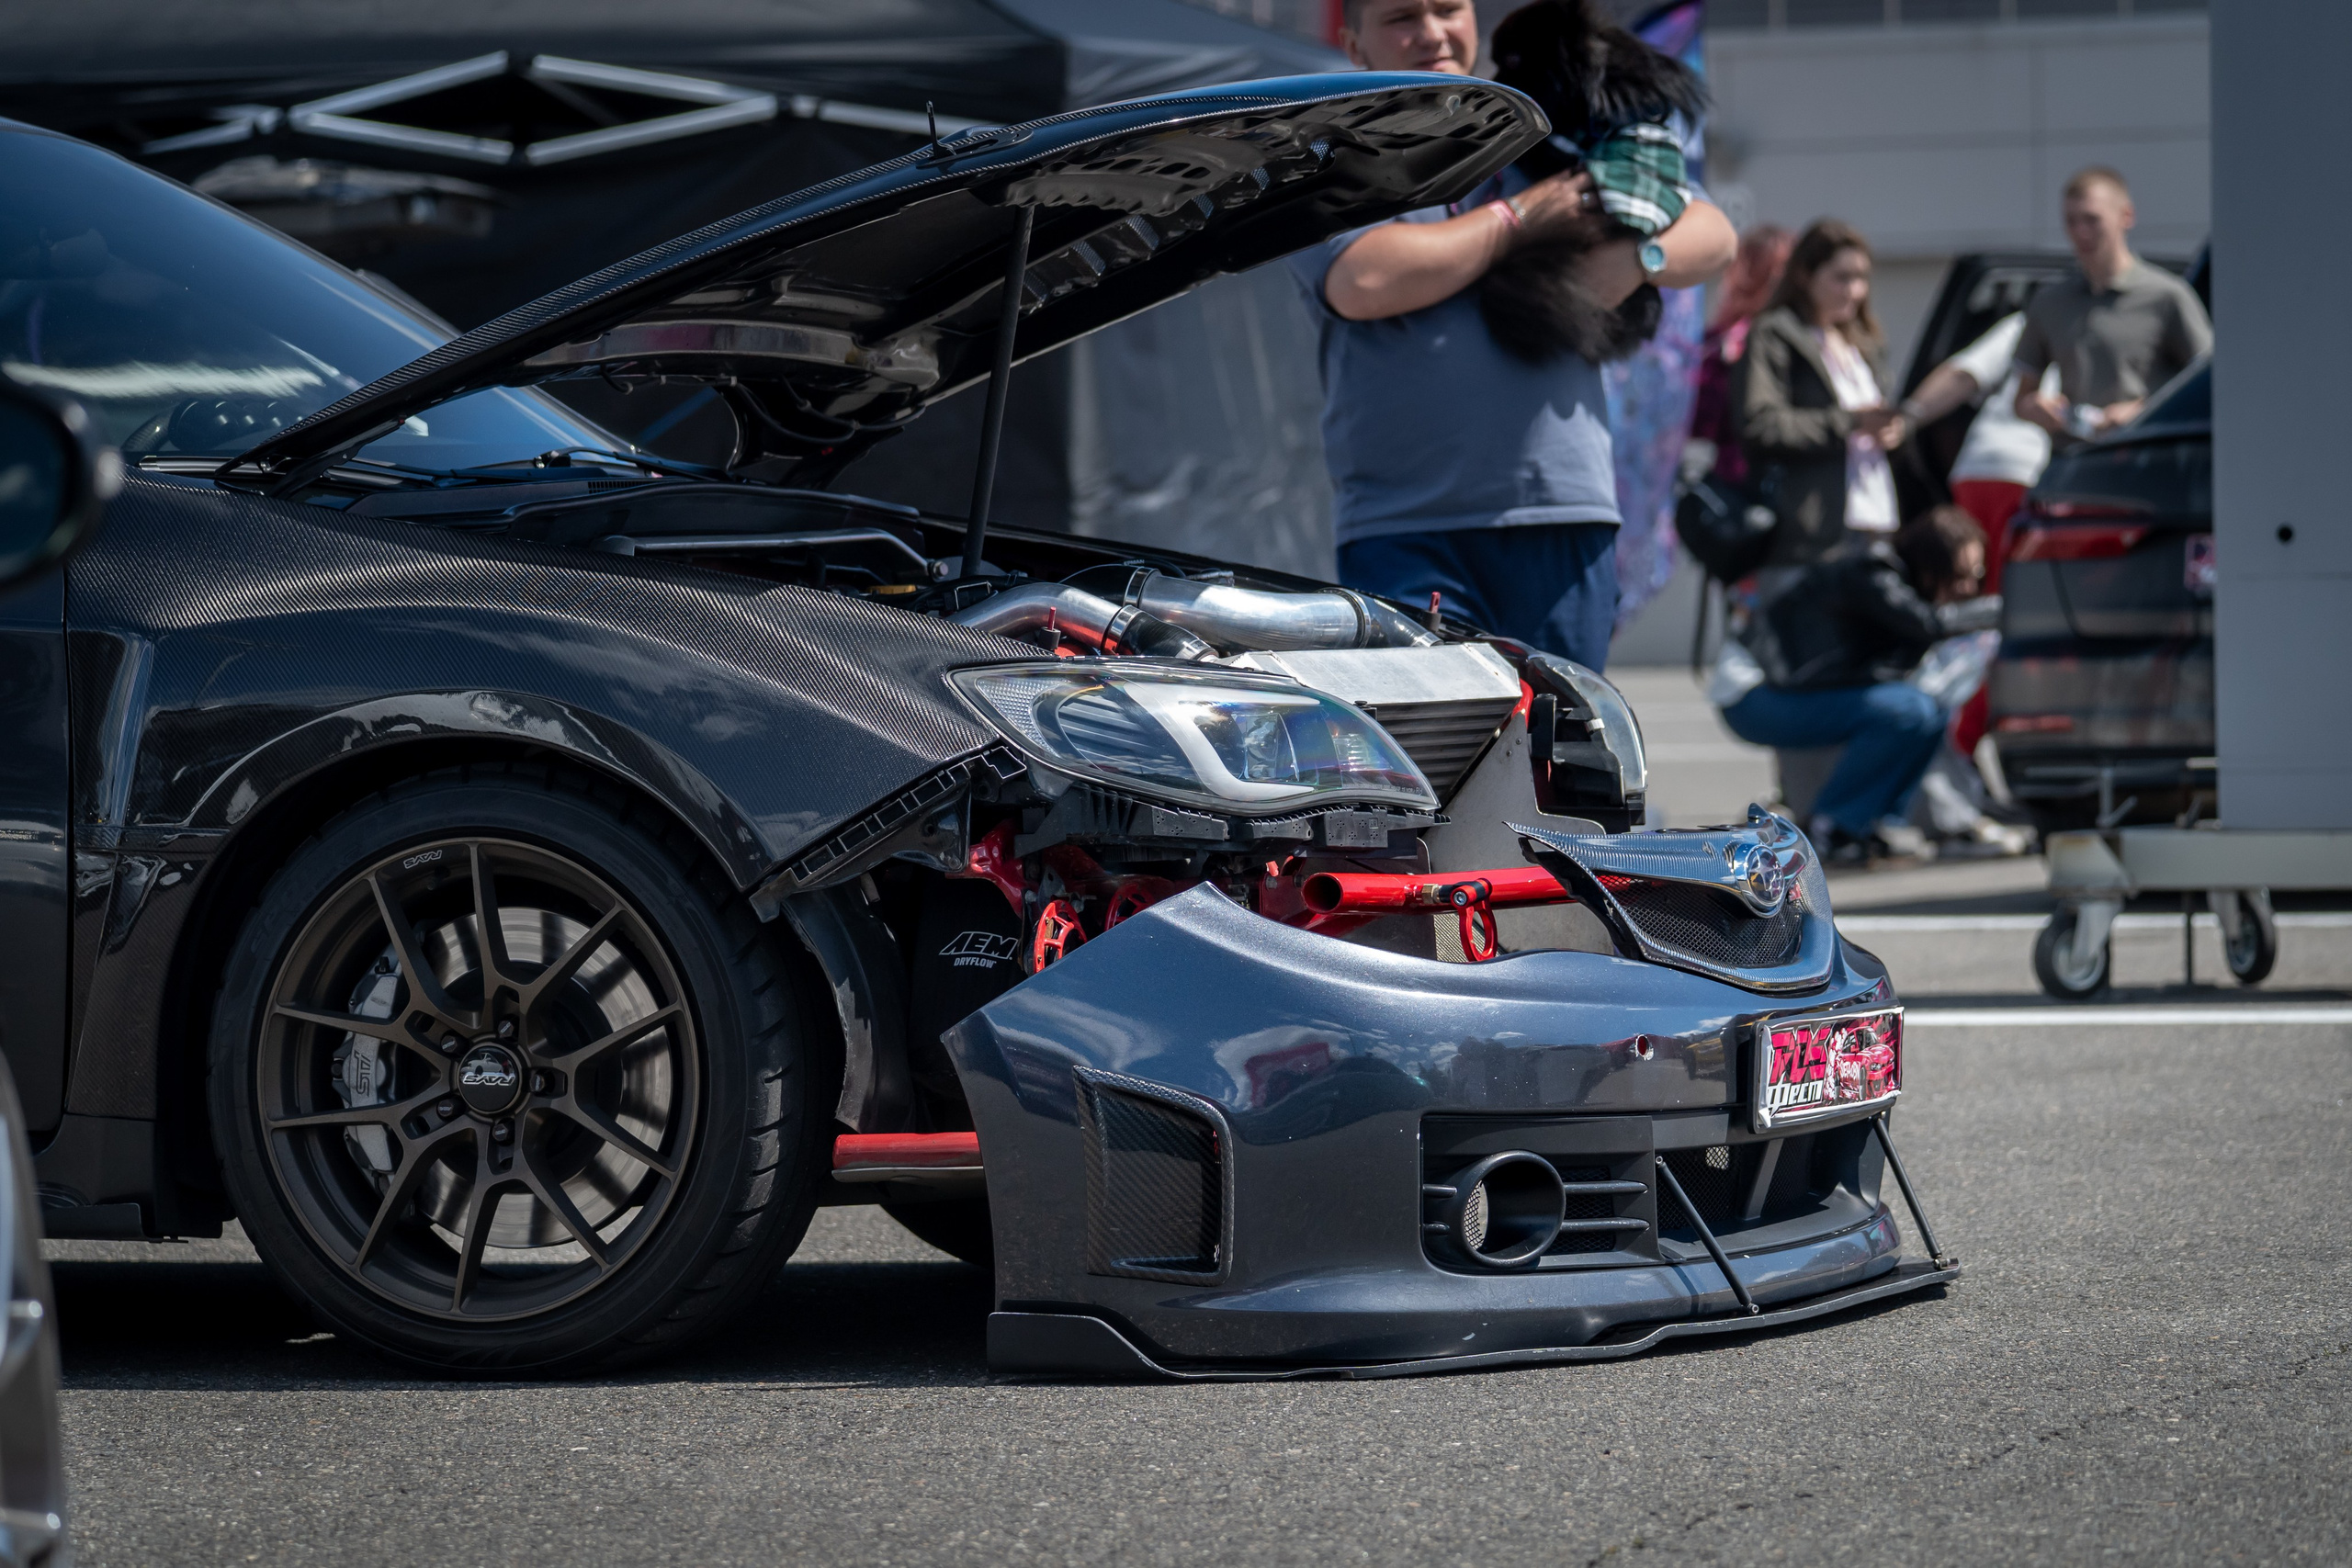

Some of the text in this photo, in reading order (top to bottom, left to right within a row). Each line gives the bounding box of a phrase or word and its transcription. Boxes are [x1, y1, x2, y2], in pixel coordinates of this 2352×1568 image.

[403, 850, 443, 869] RAYS
[938, 931, 1019, 960] AEM
[954, 956, 997, 969] DRYFLOW
[462, 1073, 516, 1087] RAYS
